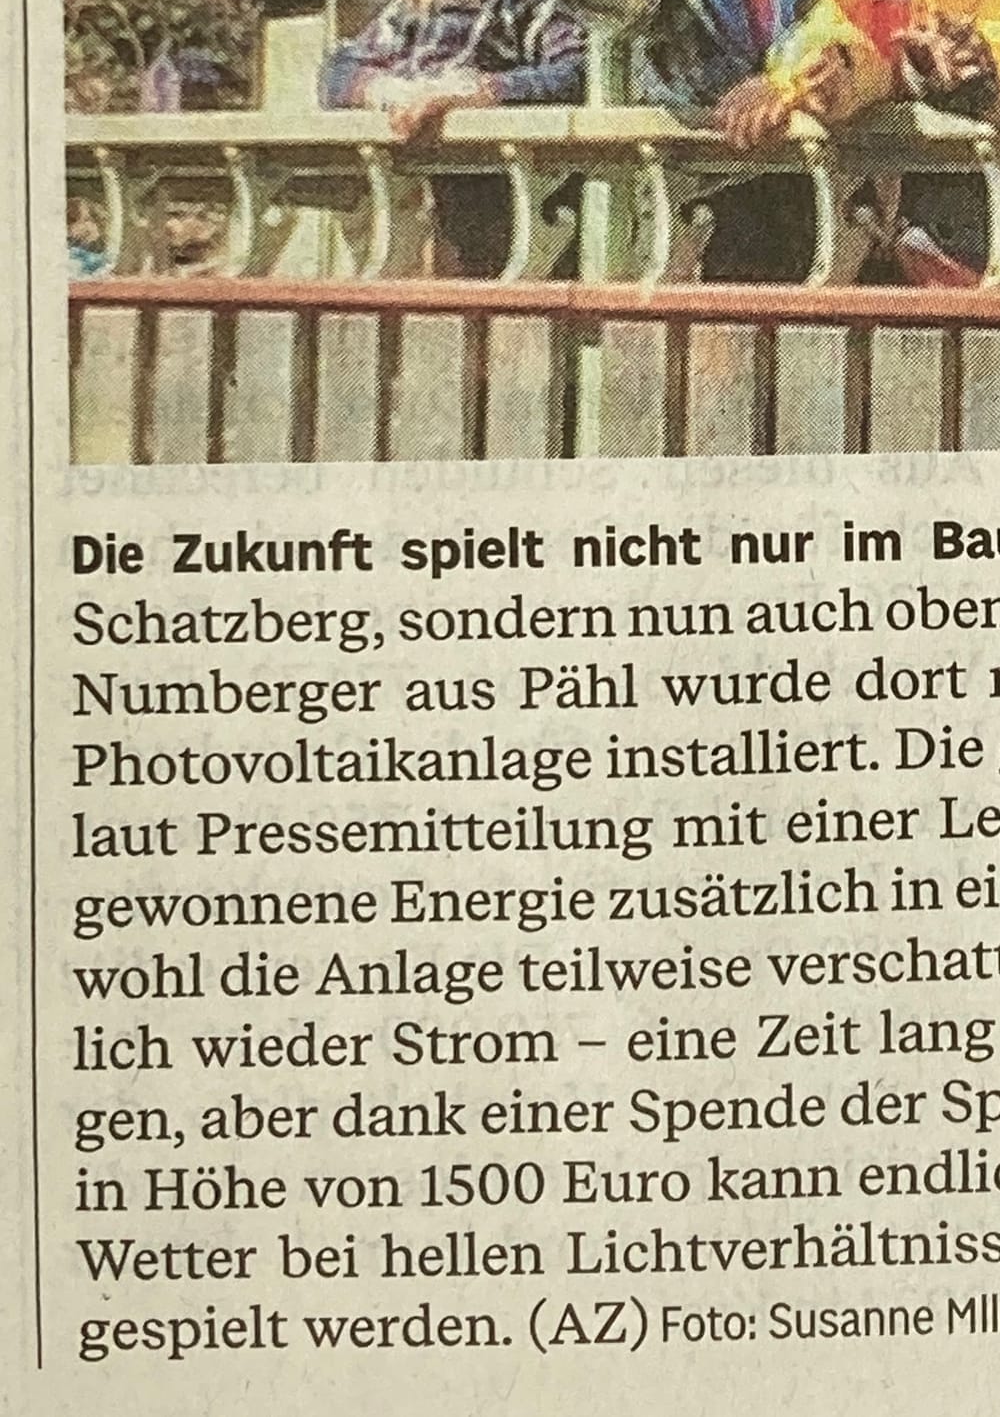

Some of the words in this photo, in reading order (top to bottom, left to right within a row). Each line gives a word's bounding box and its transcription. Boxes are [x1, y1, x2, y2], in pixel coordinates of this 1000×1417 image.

[72, 532, 145, 575] Die
[172, 528, 374, 574] Zukunft
[400, 526, 545, 580] spielt
[573, 523, 702, 568] nicht
[731, 530, 815, 565] nur
[843, 520, 902, 562] im
[72, 597, 385, 654] Schatzberg,
[398, 593, 617, 642] sondern
[627, 603, 735, 638] nun
[746, 586, 875, 635] auch
[72, 668, 382, 725] Numberger
[405, 678, 496, 712] aus
[519, 662, 639, 710] Pähl
[660, 657, 831, 707] wurde
[855, 655, 968, 702] dort
[71, 735, 592, 792] Photovoltaikanlage
[606, 728, 880, 779] installiert.
[894, 724, 984, 770] Die
[71, 811, 178, 858] laut
[196, 804, 654, 861] Pressemitteilung
[672, 801, 768, 848] mit
[786, 797, 920, 844] einer
[73, 891, 377, 941] gewonnene
[390, 875, 596, 934] Energie
[609, 866, 880, 921] zusätzlich
[890, 866, 944, 912] in
[72, 951, 206, 1000] wohl
[220, 950, 300, 997] die
[314, 948, 504, 1006] Anlage
[518, 944, 752, 992] teilweise
[72, 1023, 174, 1071] lich
[191, 1020, 374, 1069] wieder
[392, 1021, 559, 1066] Strom
[627, 1016, 737, 1062] eine
[756, 1010, 862, 1058] Zeit
[879, 1008, 996, 1064] lang
[74, 1108, 185, 1154] gen,
[200, 1092, 319, 1140] aber
[332, 1090, 467, 1138] dank
[481, 1088, 615, 1135] einer
[629, 1082, 826, 1144] Spende
[840, 1079, 928, 1127] der
[75, 1167, 129, 1212] in
[143, 1164, 287, 1212] Höhe
[303, 1175, 404, 1209] von
[420, 1161, 545, 1207] 1500
[562, 1160, 691, 1204] Euro
[707, 1155, 843, 1202] kann
[75, 1238, 258, 1282] Wetter
[277, 1233, 360, 1279] bei
[380, 1230, 546, 1278] hellen
[78, 1303, 289, 1363] gespielt
[302, 1302, 513, 1349] werden.
[529, 1295, 648, 1355] (AZ)
[662, 1305, 757, 1343] Foto:
[768, 1301, 934, 1340] Susanne
